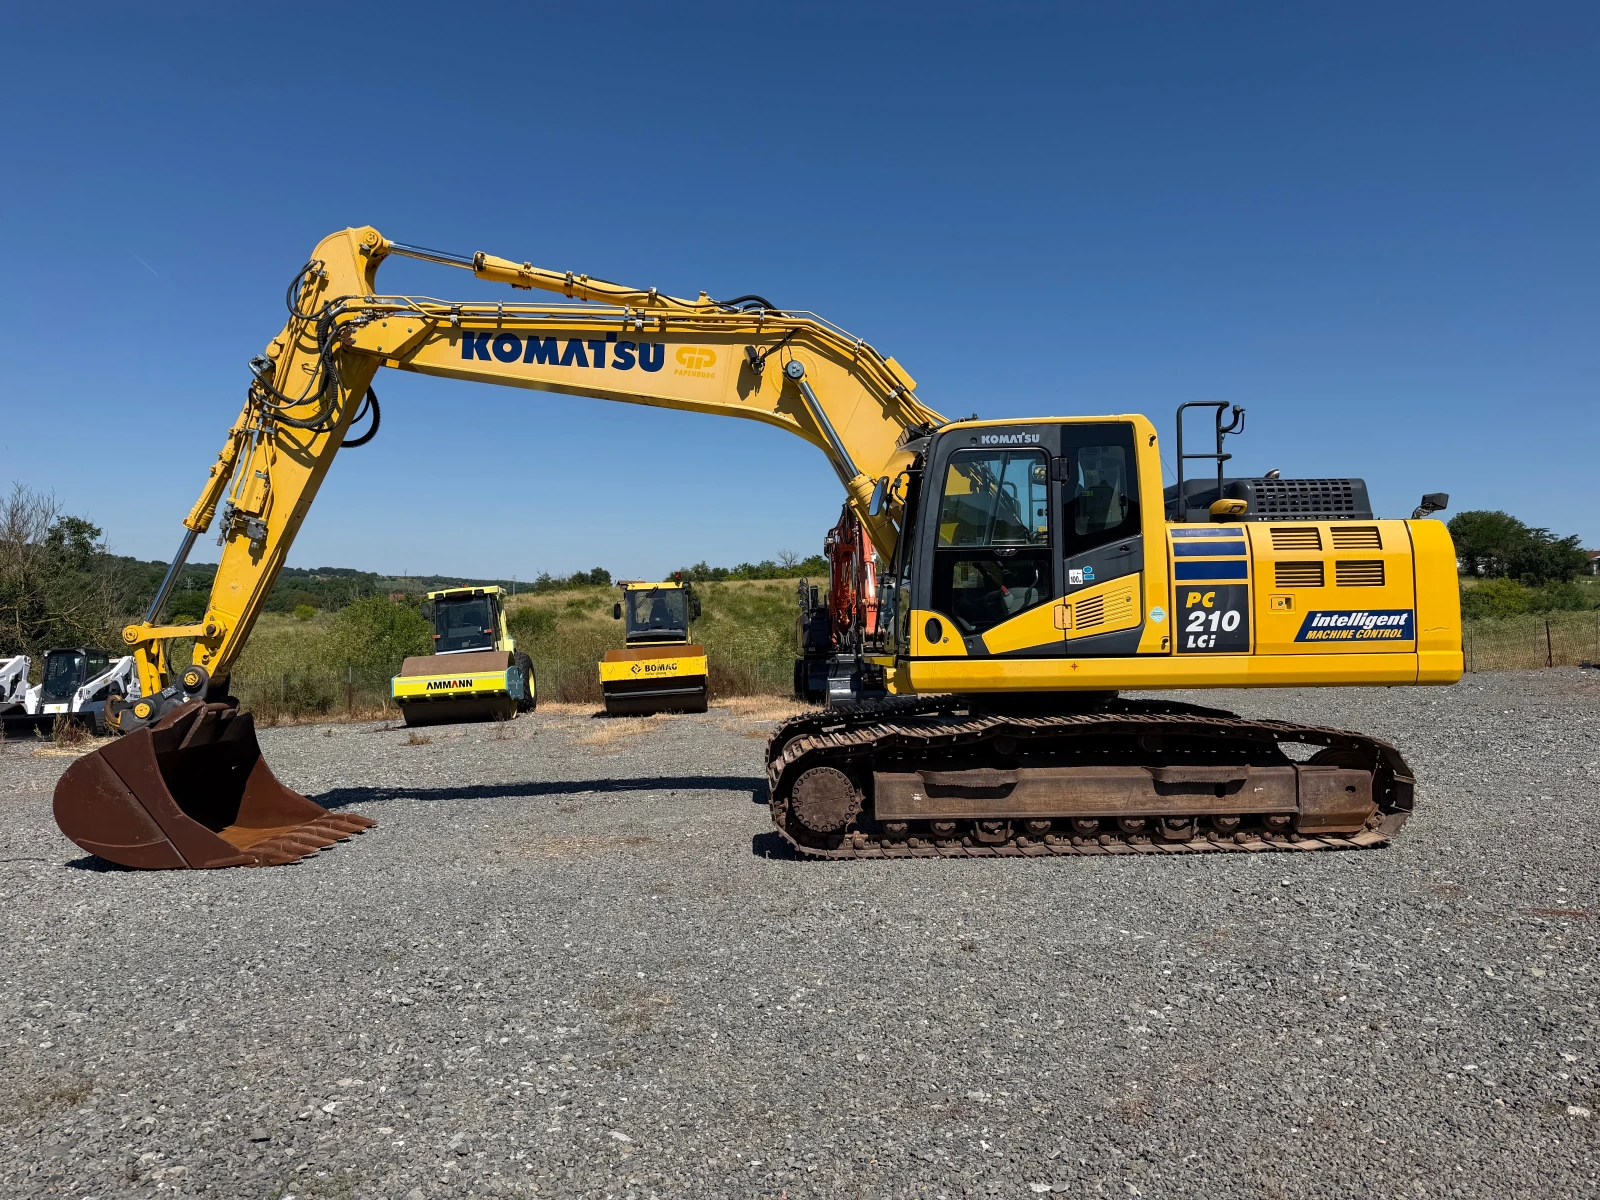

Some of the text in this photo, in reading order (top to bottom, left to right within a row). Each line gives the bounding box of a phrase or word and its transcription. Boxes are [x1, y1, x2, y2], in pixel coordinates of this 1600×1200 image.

[461, 331, 665, 372] KOMATSU
[674, 369, 716, 379] PAPENBURG
[981, 431, 1040, 444] KOMATSU
[1185, 591, 1216, 608] PC
[1185, 610, 1241, 632] 210
[1311, 612, 1408, 630] intelligent
[1305, 628, 1403, 640] MACHINE CONTROL
[1186, 634, 1217, 648] LCi
[644, 663, 678, 672] BOMAG
[426, 679, 473, 690] AMMANN
